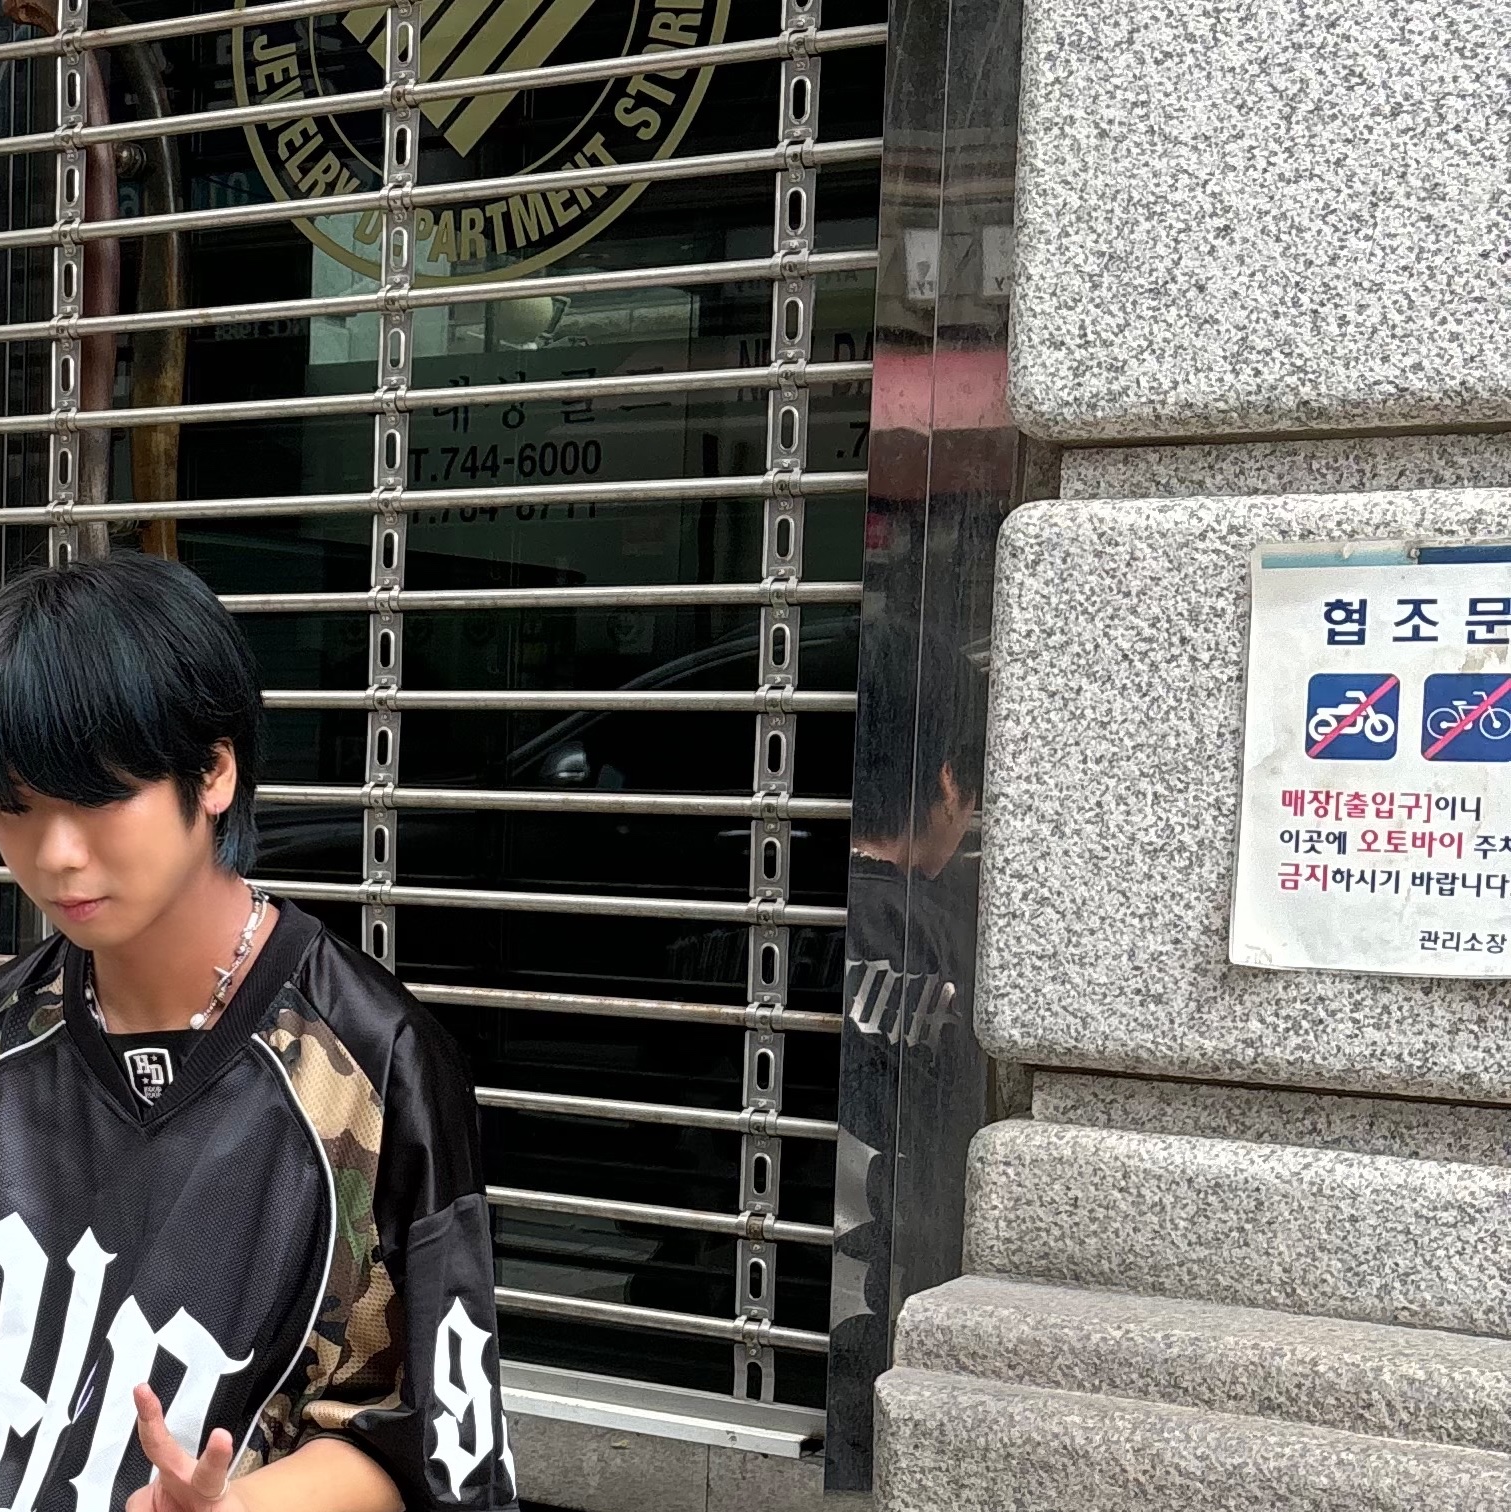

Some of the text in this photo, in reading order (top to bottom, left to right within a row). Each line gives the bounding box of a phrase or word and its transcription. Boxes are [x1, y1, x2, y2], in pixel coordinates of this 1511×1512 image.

[353, 132, 617, 262] DPARTMENT
[614, 0, 704, 140] STOR
[408, 439, 602, 483] T.744-6000
[1281, 789, 1482, 824] 매장[출입구]이니
[1279, 829, 1347, 855] 이곳에
[1357, 828, 1464, 859] 오토바이
[1277, 862, 1400, 894] 금지하시기
[1419, 930, 1507, 955] 관리소장
